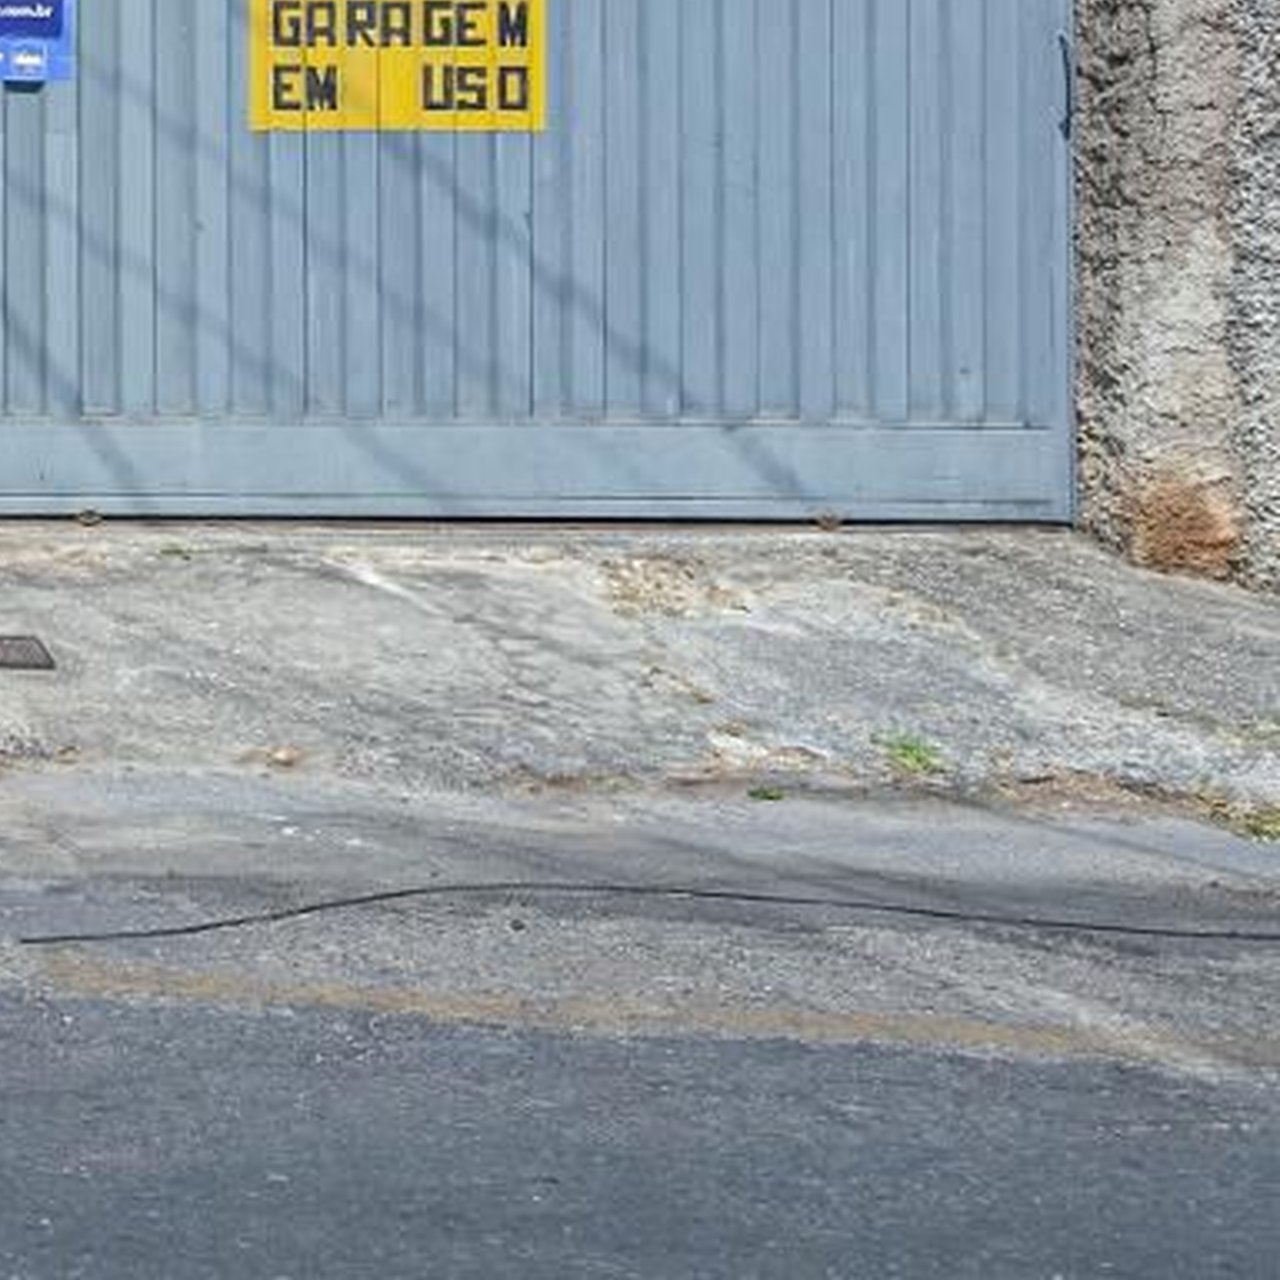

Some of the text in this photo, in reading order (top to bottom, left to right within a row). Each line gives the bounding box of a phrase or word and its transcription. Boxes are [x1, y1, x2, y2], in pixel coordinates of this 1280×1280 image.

[272, 0, 528, 47] GARAGEM
[272, 65, 528, 111] EM USO
